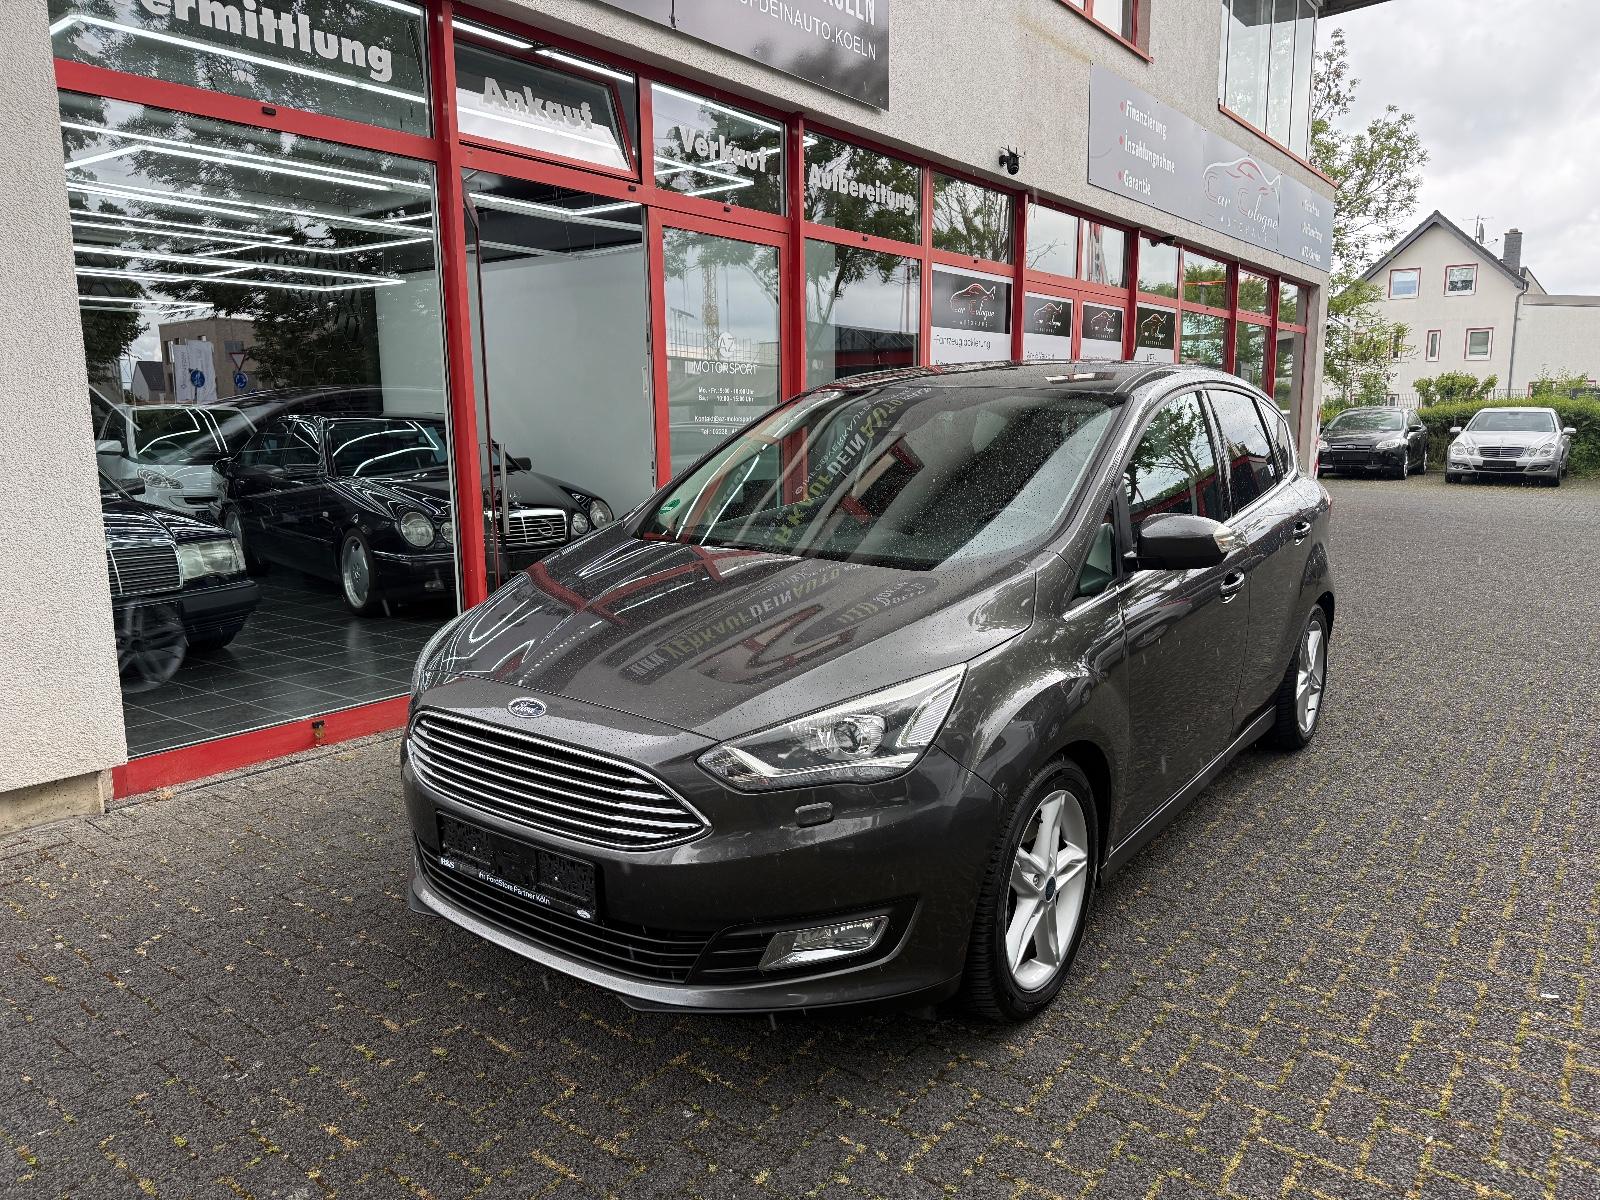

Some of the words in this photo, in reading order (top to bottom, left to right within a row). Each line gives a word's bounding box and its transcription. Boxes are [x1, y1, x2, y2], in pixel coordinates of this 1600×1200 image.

[482, 76, 593, 129] Ankauf
[1125, 100, 1167, 141] Finanzierung
[679, 125, 767, 172] Verkauf
[808, 163, 915, 216] Aufbereitung
[1123, 169, 1151, 196] Garantie
[693, 360, 758, 375] MOTORSPORT
[511, 701, 538, 714] Ford
[513, 885, 536, 900] Partner
